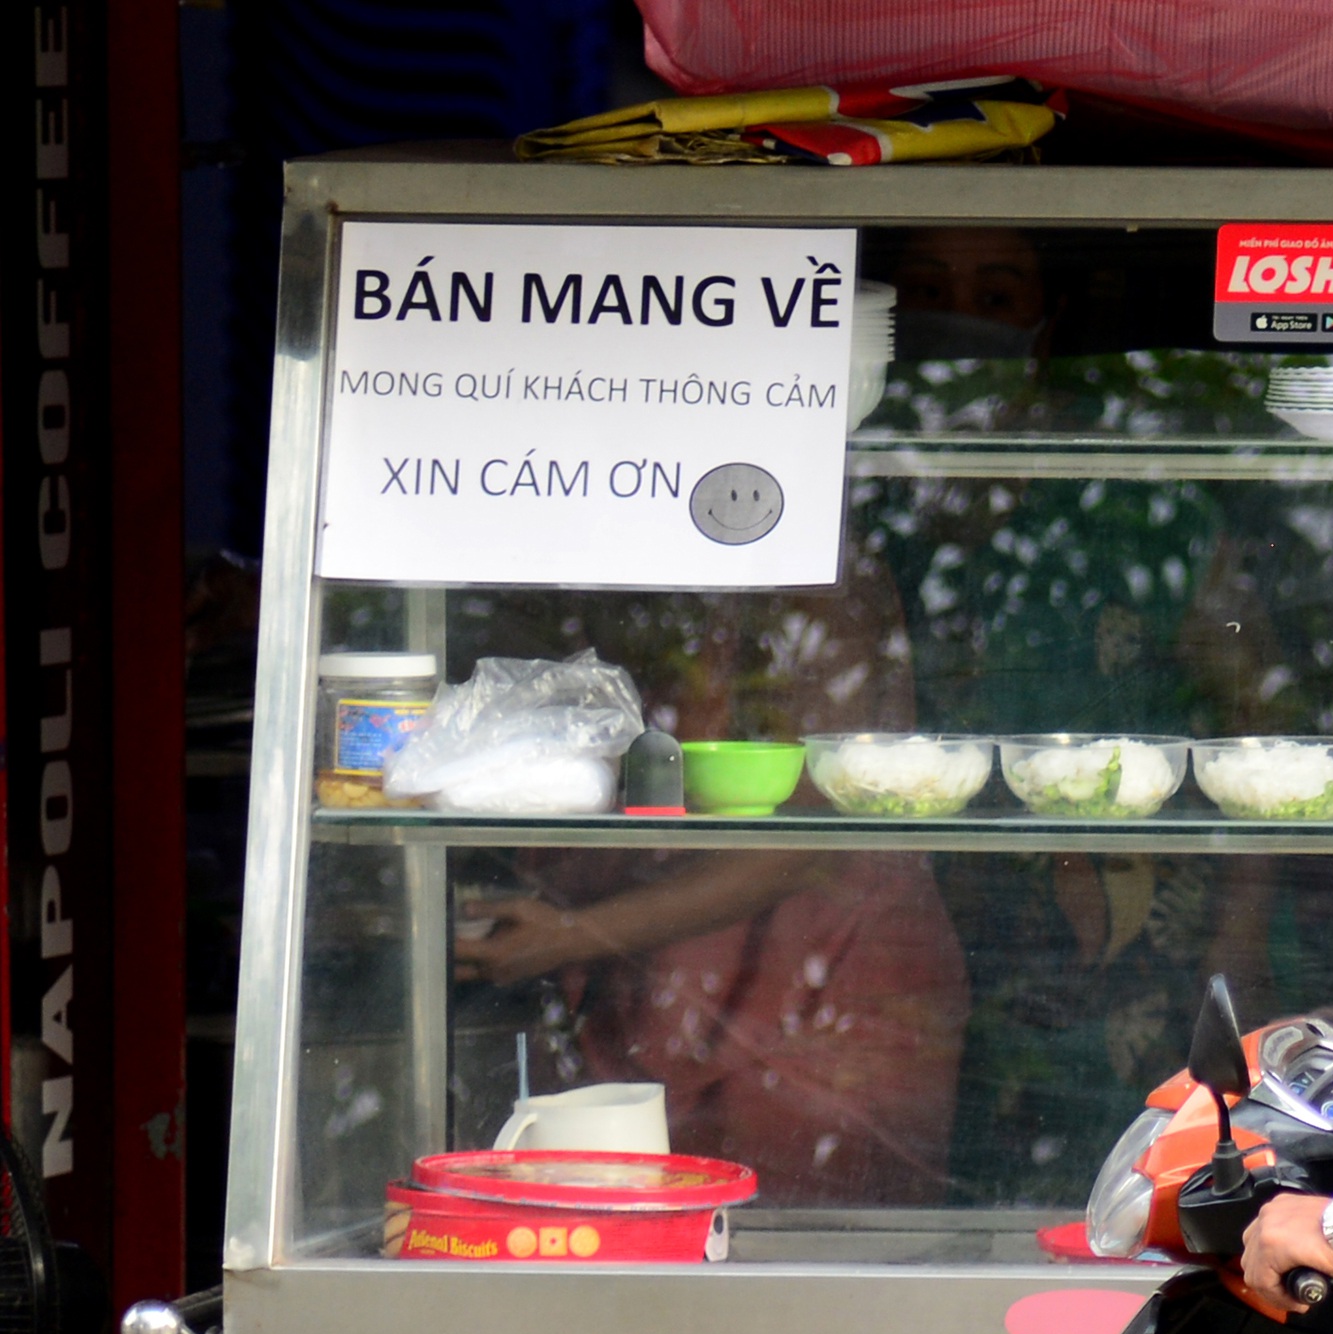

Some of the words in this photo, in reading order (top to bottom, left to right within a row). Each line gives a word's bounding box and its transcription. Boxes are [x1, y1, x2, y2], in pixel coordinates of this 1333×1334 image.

[35, 6, 71, 570] COFFEE
[354, 256, 494, 322] BÁN
[521, 272, 736, 327] MANG
[761, 256, 842, 328] VỀ
[340, 370, 442, 397] MONG
[454, 368, 516, 400] QUÍ
[523, 369, 627, 403] KHÁCH
[639, 372, 751, 407] THÔNG
[766, 372, 836, 408] CẢM
[380, 456, 461, 496] XIN
[480, 449, 589, 498] CÁM
[609, 457, 681, 499] ƠN
[41, 627, 73, 1178] NAPOLI
[450, 1236, 498, 1258] Biscuits
